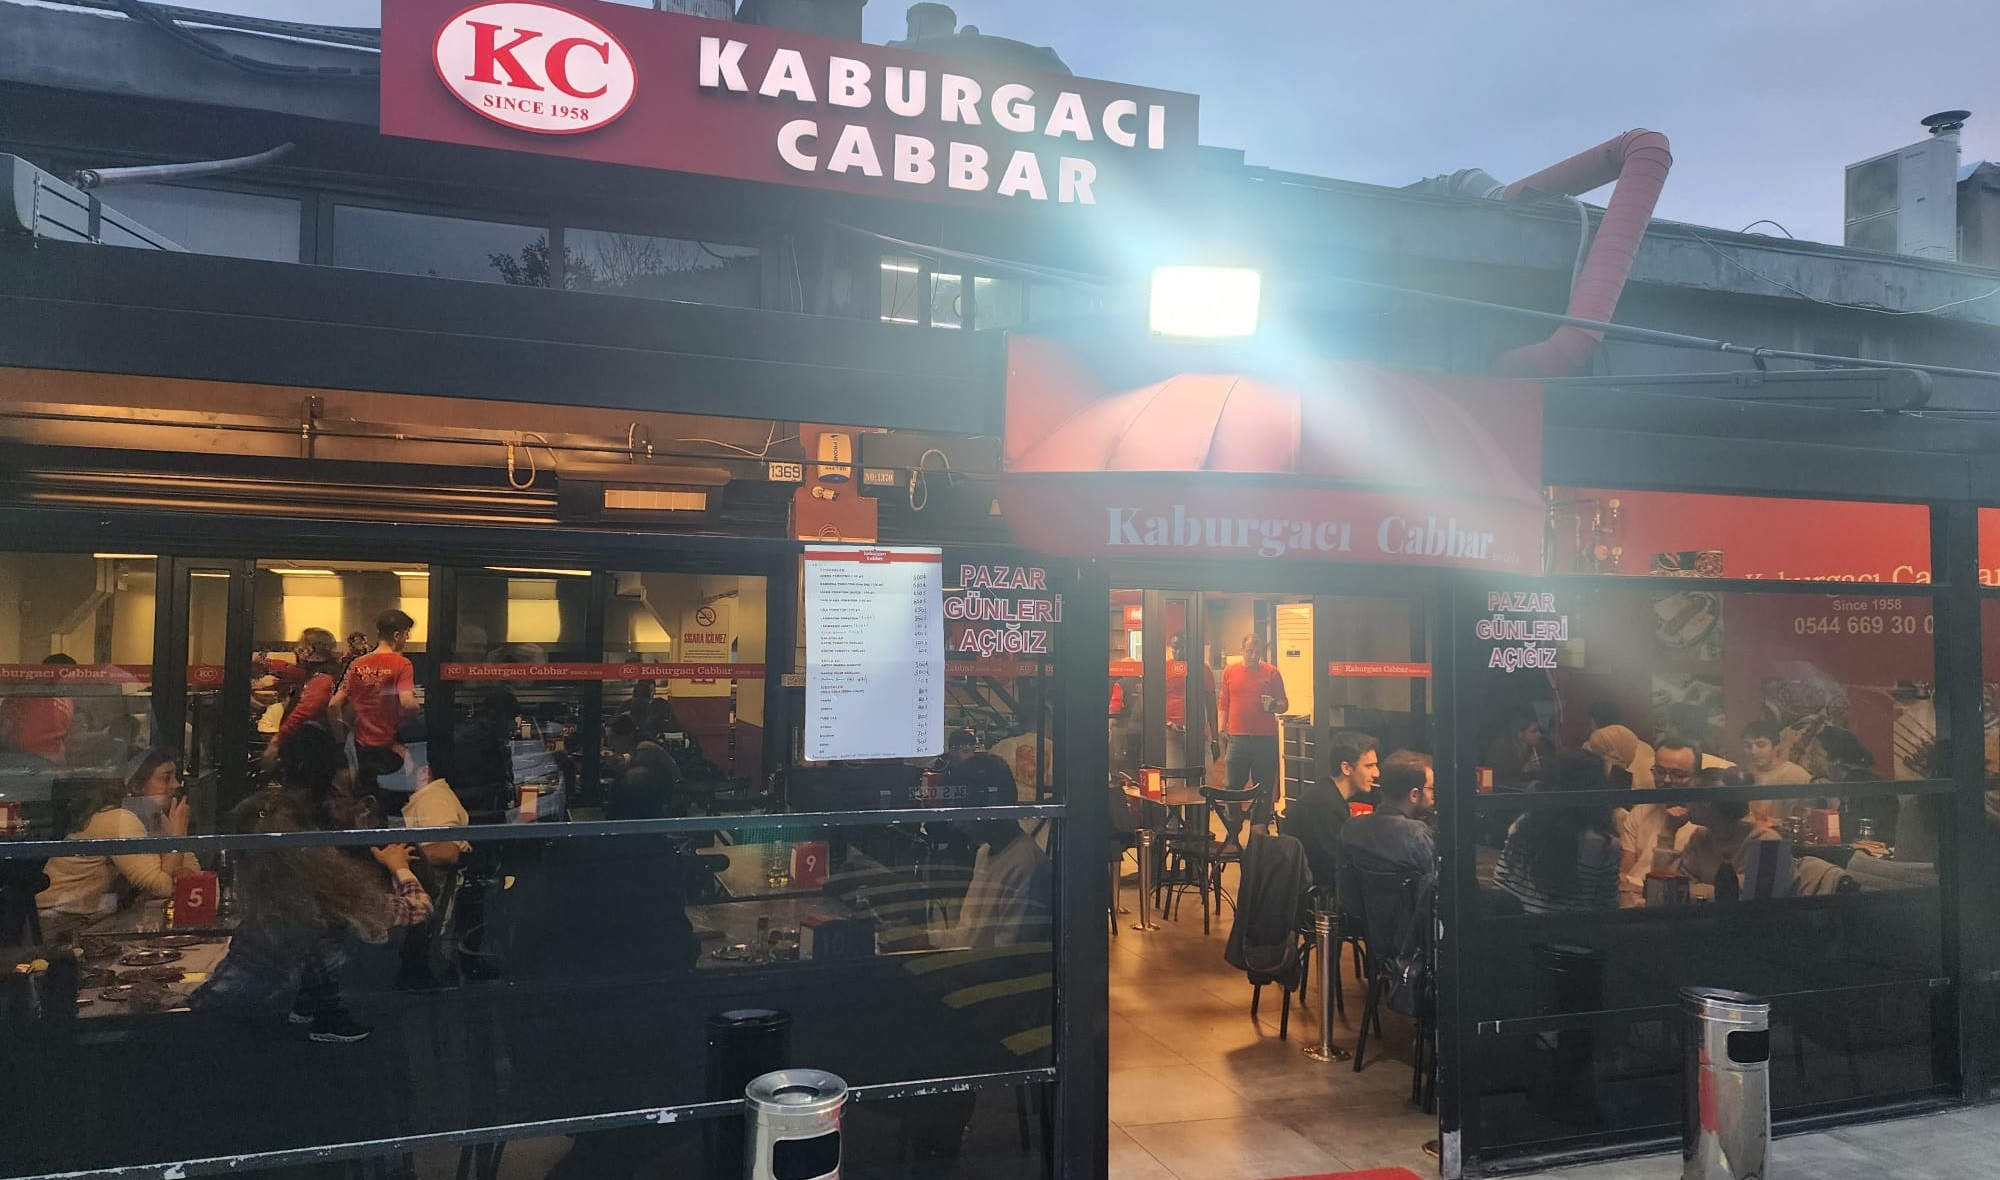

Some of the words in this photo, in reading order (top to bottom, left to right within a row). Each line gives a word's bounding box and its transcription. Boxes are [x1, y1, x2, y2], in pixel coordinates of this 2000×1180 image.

[464, 20, 609, 99] KC
[699, 36, 1165, 150] KABURGACI
[483, 94, 544, 115] SINCE
[551, 104, 589, 121] 1958
[777, 119, 1097, 205] CABBAR
[770, 464, 800, 478] 1369
[1105, 504, 1352, 559] Kaburgacı
[1377, 515, 1494, 560] Cabbar
[959, 564, 1047, 590] PAZAR
[943, 590, 1062, 622] GÜNLERİ
[1487, 591, 1556, 613] PAZAR
[1832, 599, 1868, 611] Since
[1872, 598, 1902, 610] 1958
[1475, 613, 1568, 641] GÜNLERİ
[1794, 615, 1841, 635] 0544
[1848, 615, 1884, 634] 669
[1891, 615, 1916, 634] 30
[1923, 614, 1934, 634] 0
[959, 622, 1047, 657] AÇIĞIZ
[1488, 641, 1558, 673] AÇIĞIZ
[469, 666, 526, 677] Kaburgacı
[529, 666, 568, 675] Cabbar
[640, 666, 694, 677] Kaburgacı
[697, 666, 732, 675] Cabbar
[806, 855, 817, 873] 9
[187, 887, 204, 908] 5
